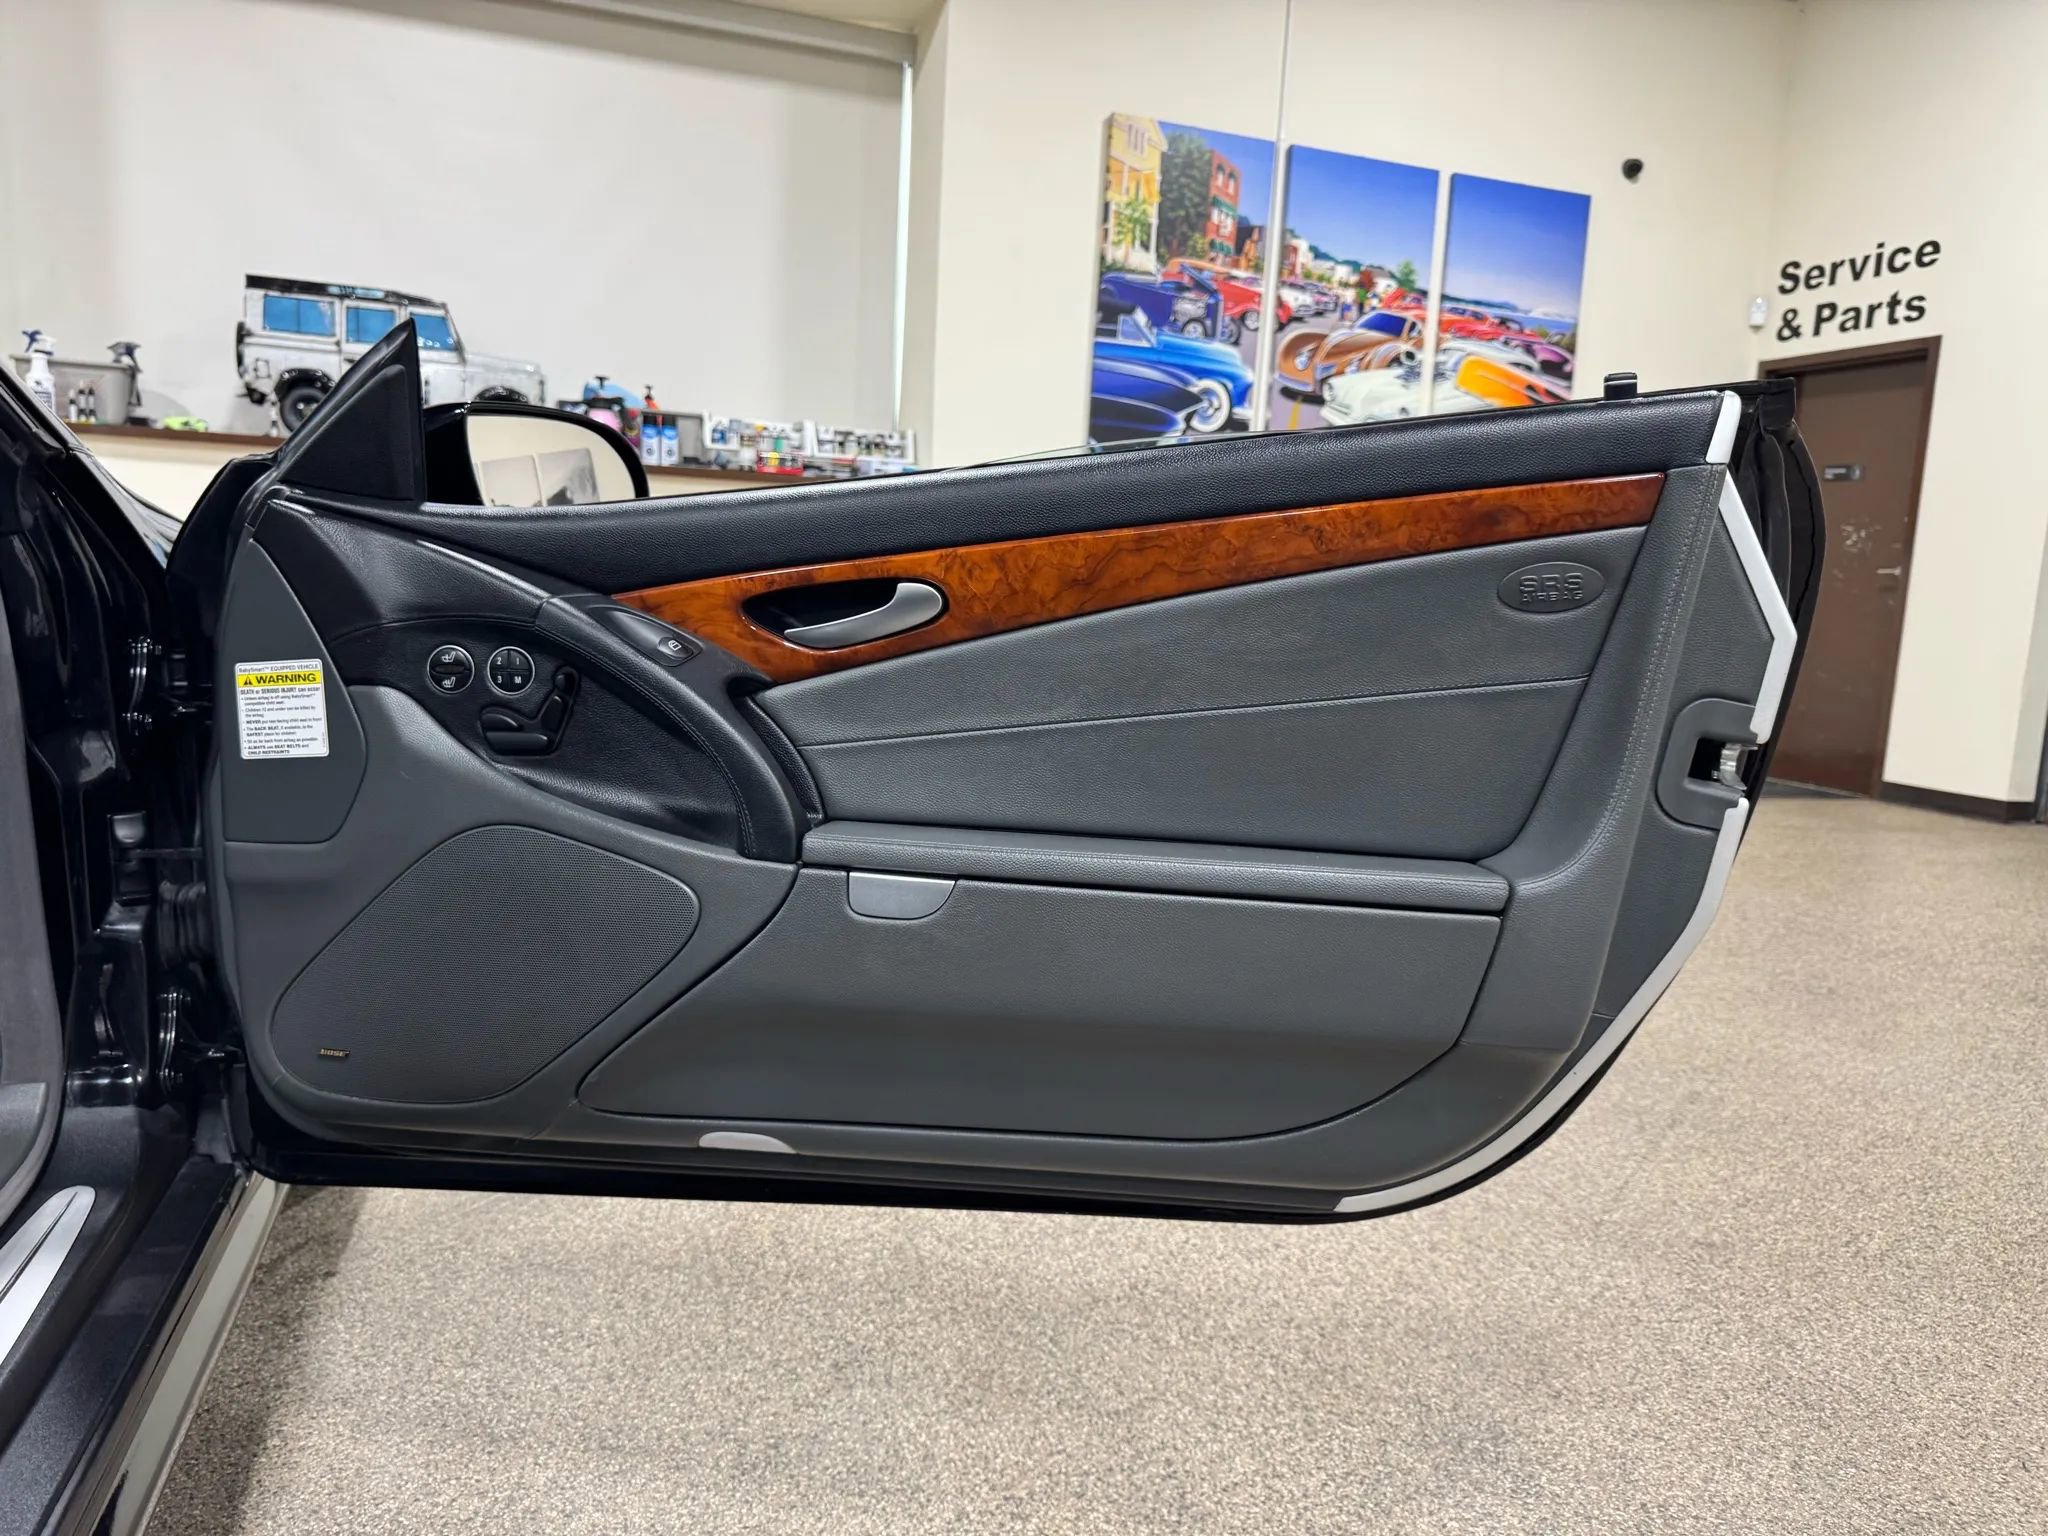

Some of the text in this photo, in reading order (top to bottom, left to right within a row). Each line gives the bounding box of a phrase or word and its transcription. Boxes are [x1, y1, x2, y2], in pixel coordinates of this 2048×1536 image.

[1778, 240, 1941, 295] Service
[1777, 290, 1927, 342] & Parts
[1520, 572, 1584, 593] SRS
[496, 656, 502, 664] 2
[256, 673, 316, 684] WARNING
[497, 676, 502, 684] 3
